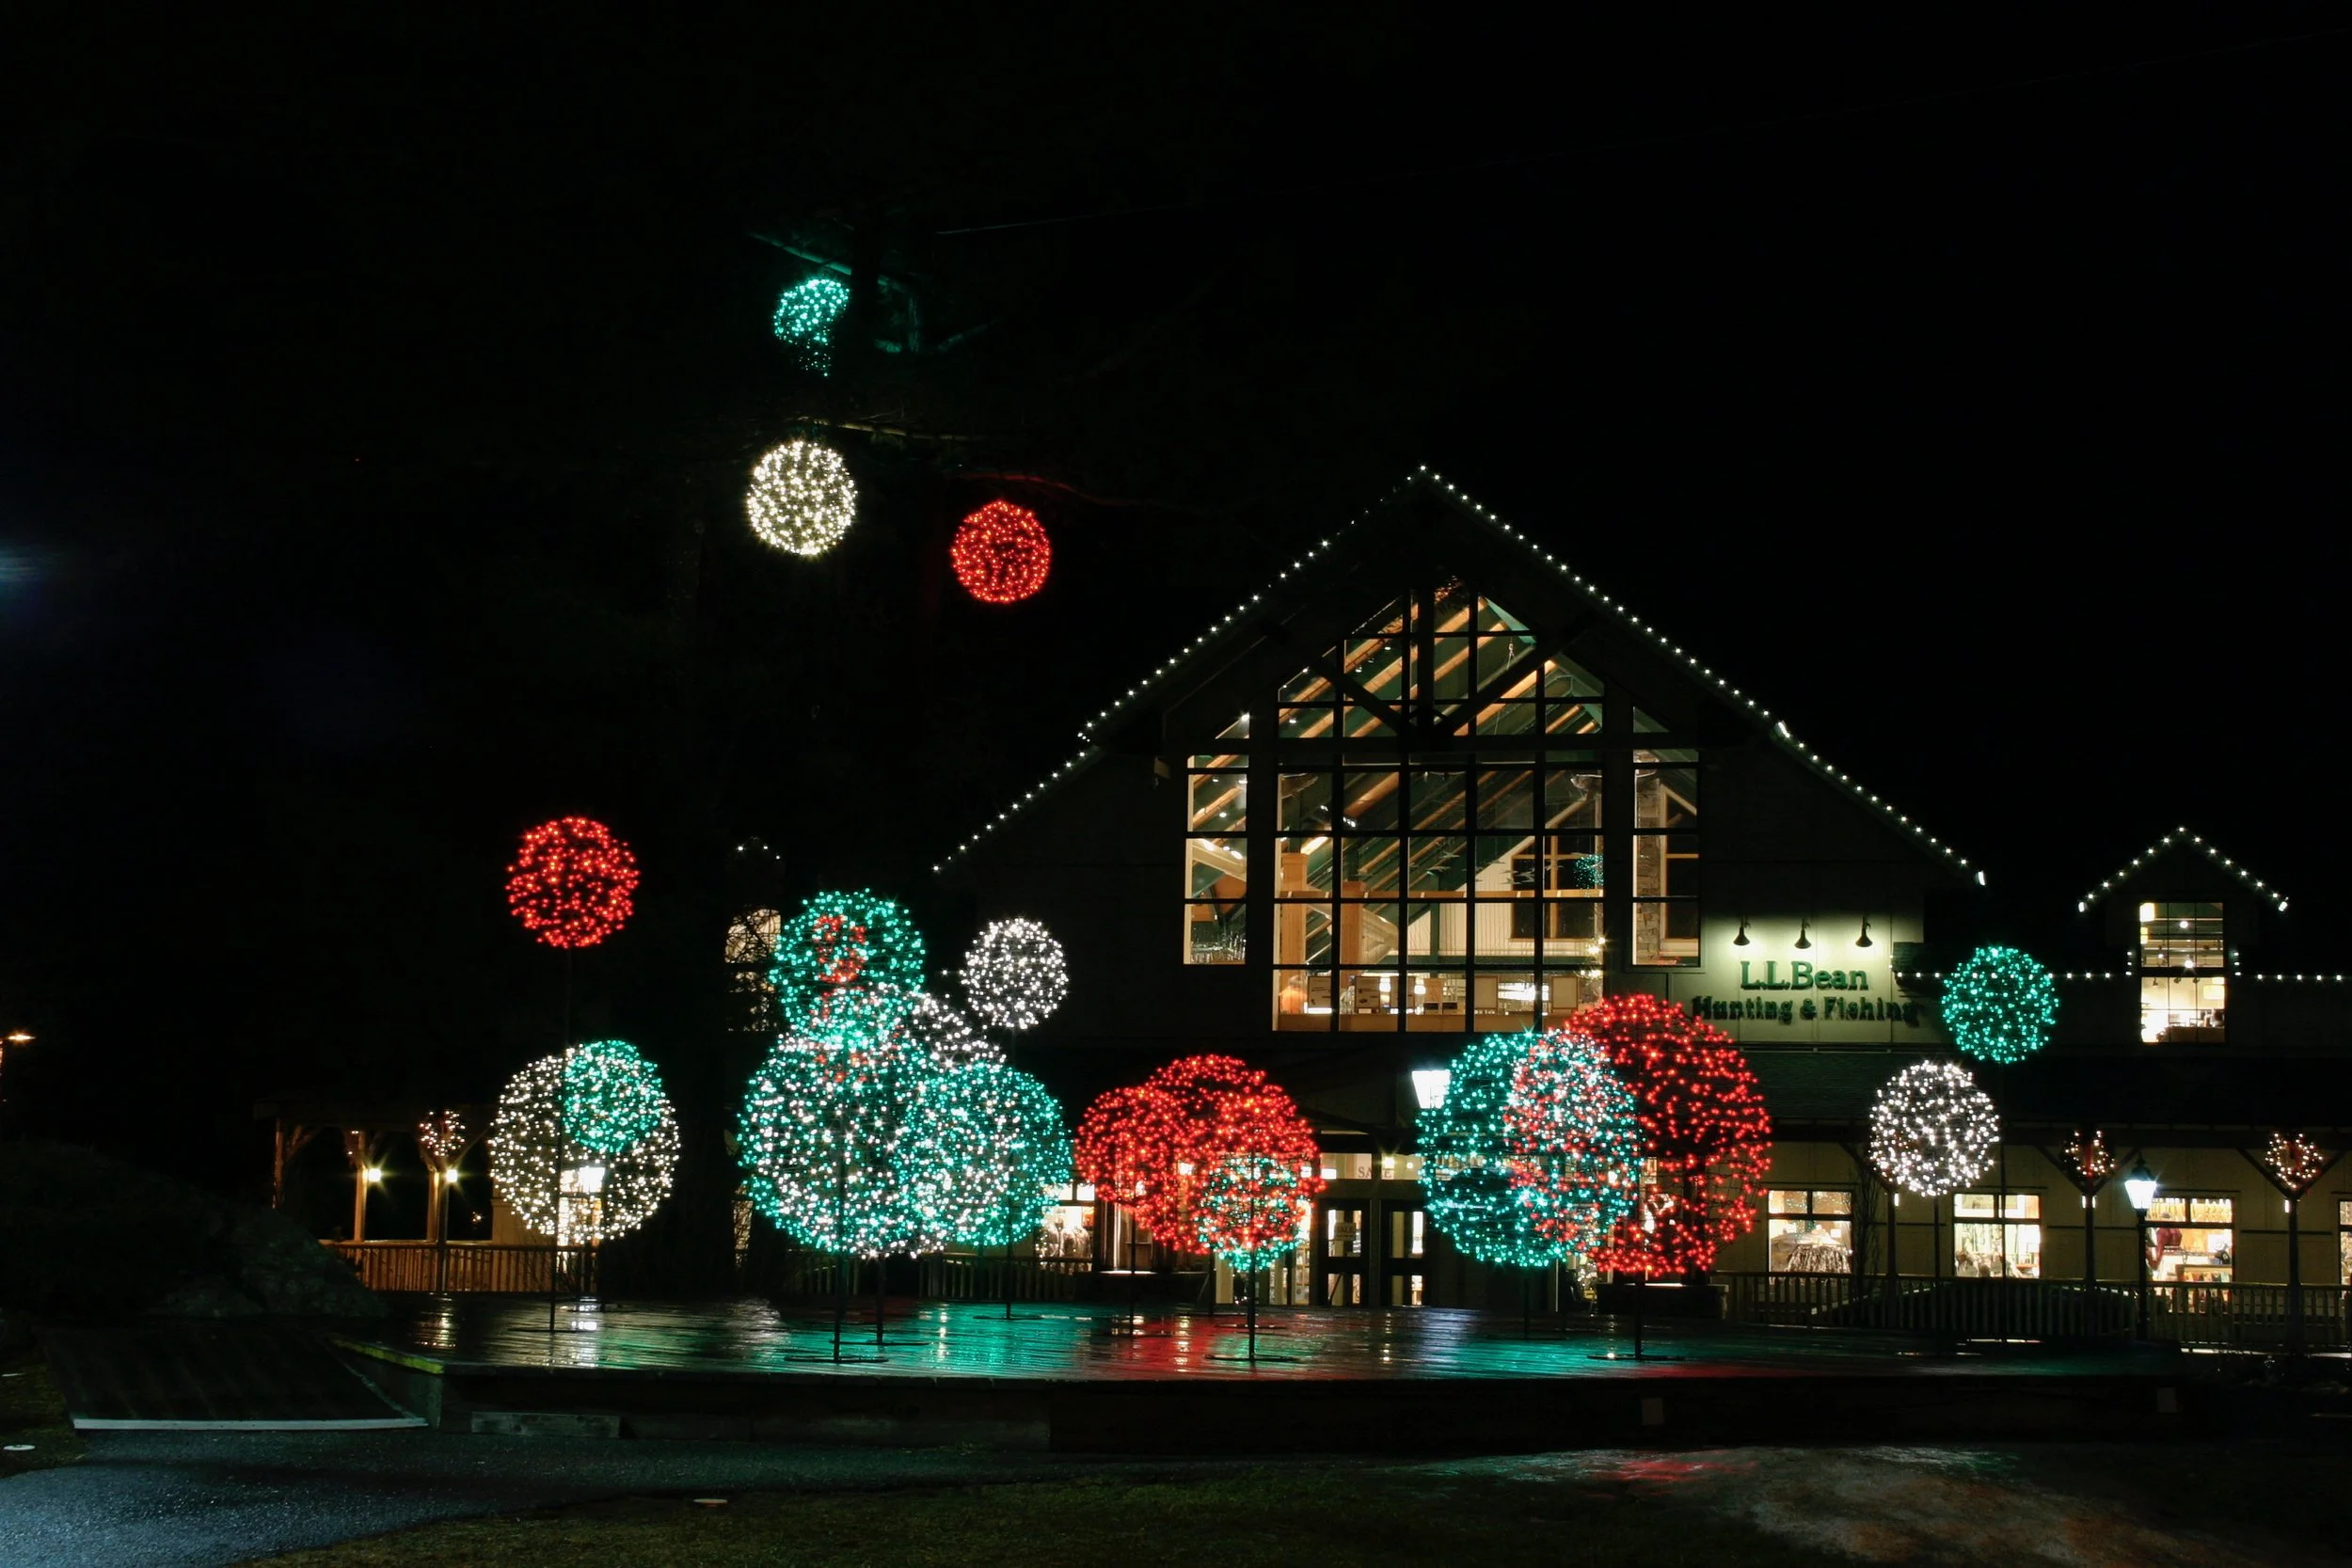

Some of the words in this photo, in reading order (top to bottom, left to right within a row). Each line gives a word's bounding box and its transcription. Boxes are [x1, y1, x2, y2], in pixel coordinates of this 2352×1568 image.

[1692, 995, 1793, 1023] Hunting
[1801, 997, 1818, 1020] &
[1823, 996, 1920, 1025] Fishing
